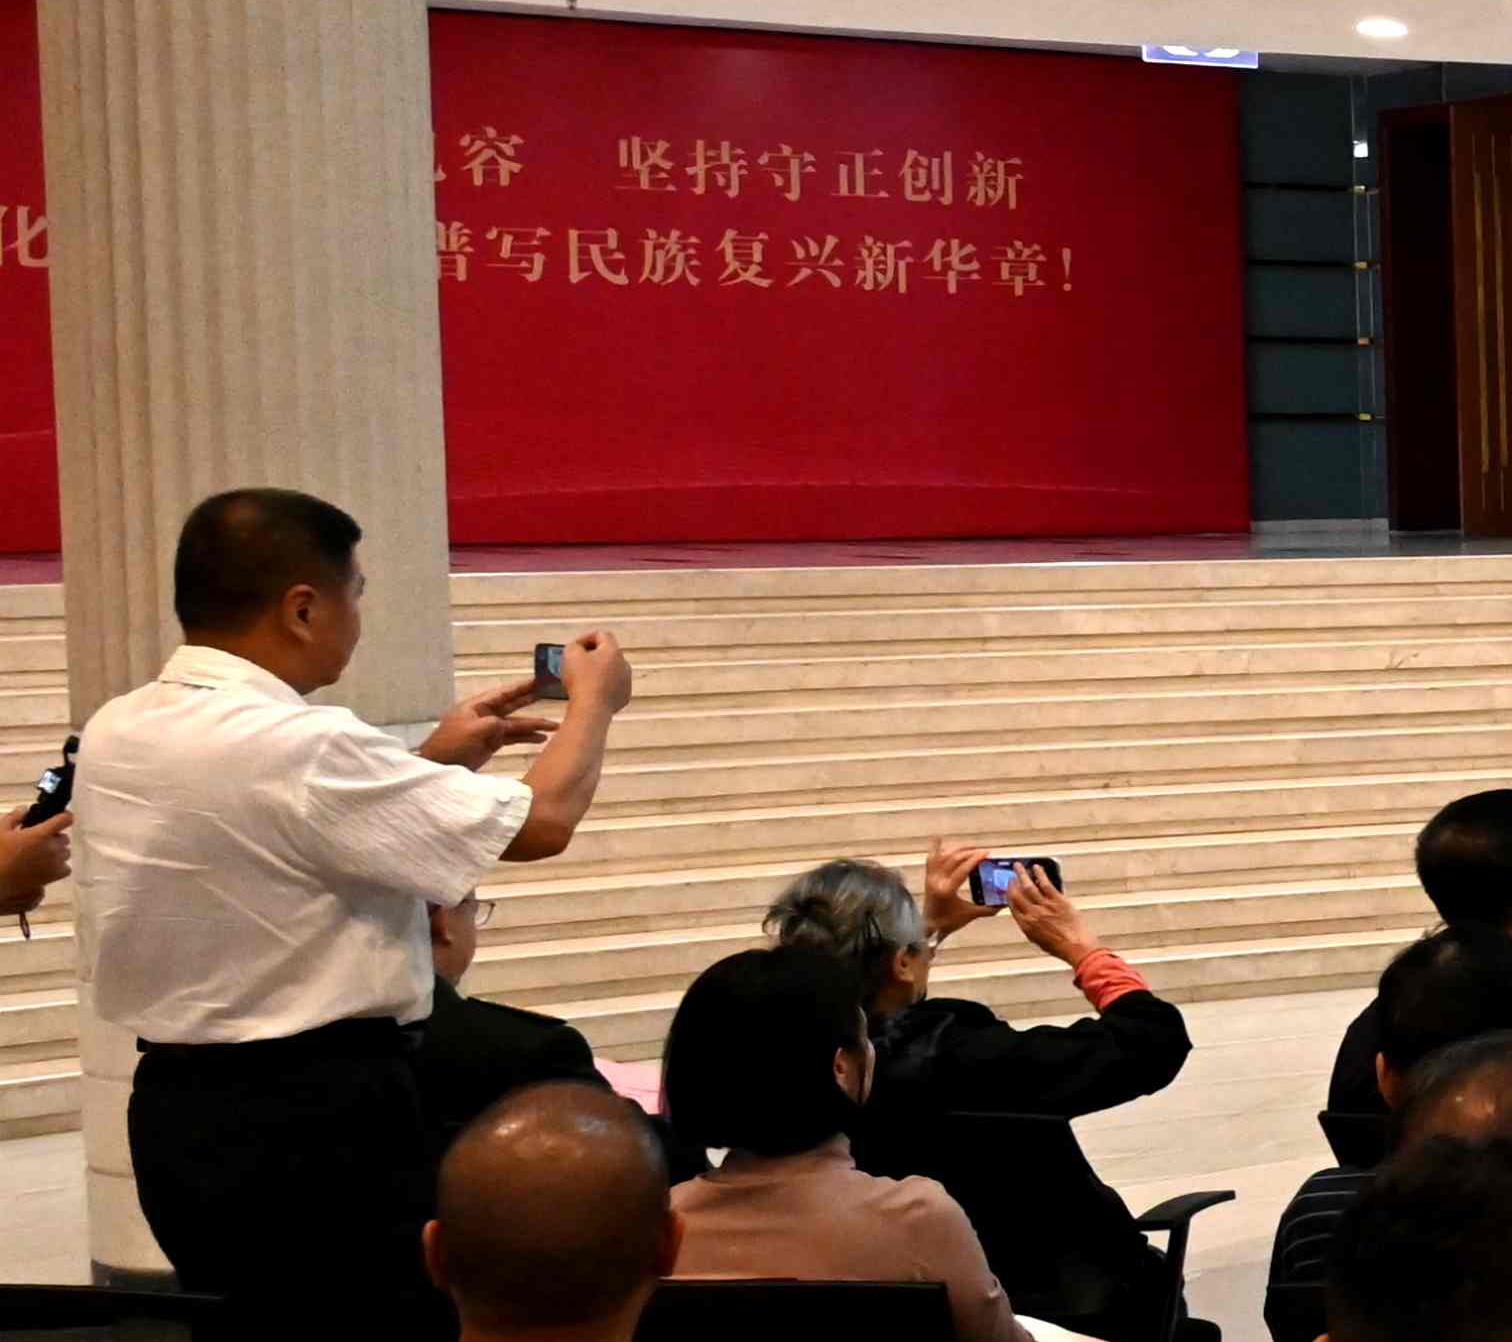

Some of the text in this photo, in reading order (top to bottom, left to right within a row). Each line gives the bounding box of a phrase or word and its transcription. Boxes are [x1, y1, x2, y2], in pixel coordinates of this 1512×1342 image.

[434, 126, 1023, 211] 容 坚持守正创新
